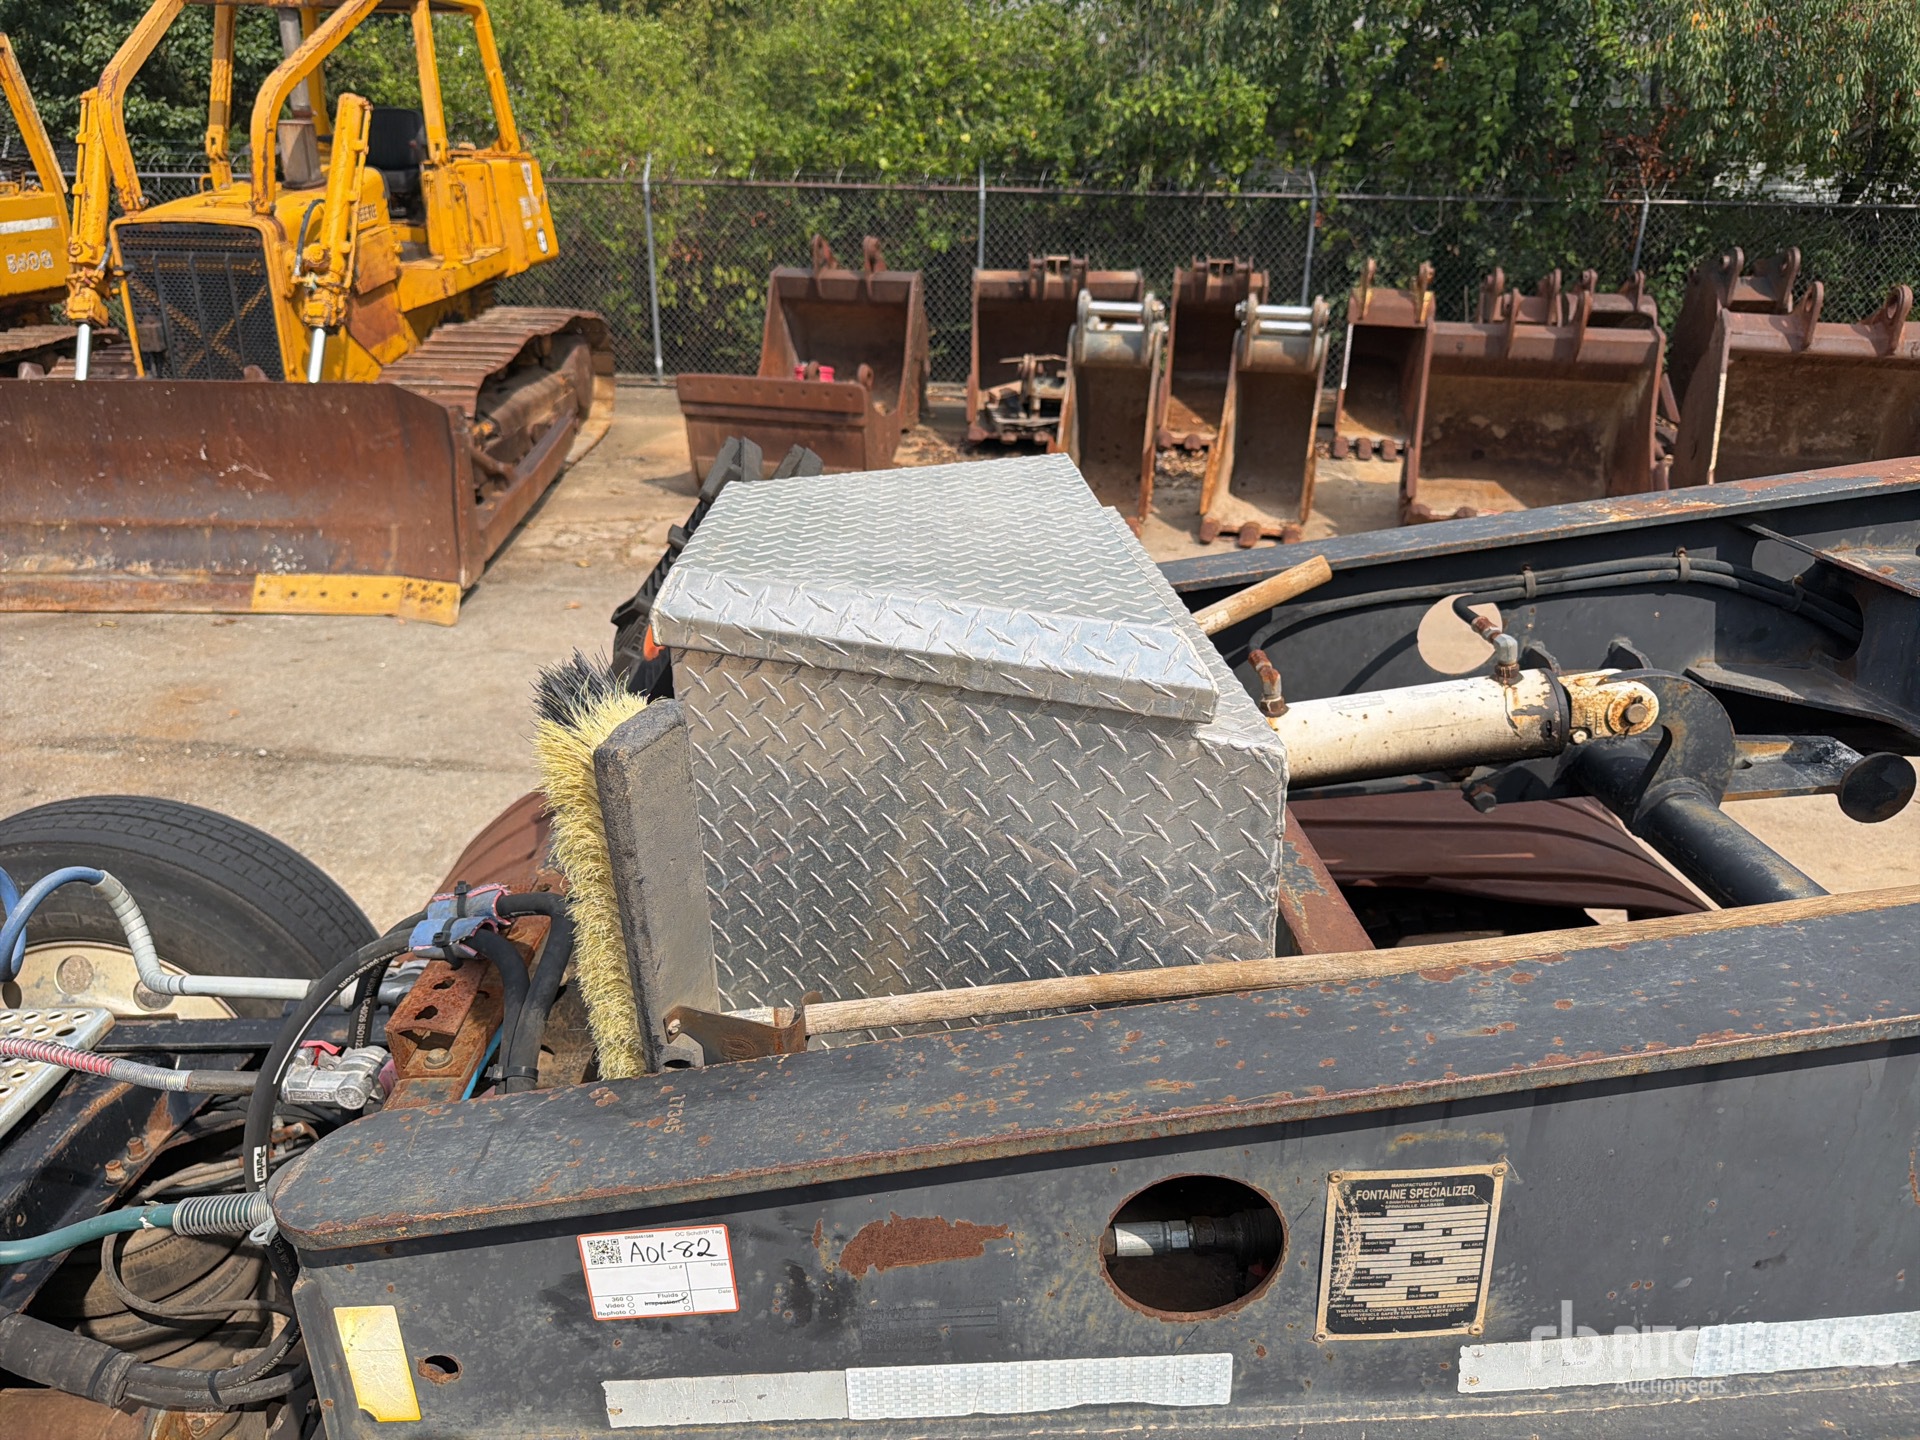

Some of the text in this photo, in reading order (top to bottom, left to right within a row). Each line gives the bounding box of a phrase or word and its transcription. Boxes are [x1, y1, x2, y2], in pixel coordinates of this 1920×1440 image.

[338, 950, 399, 989] www.parker.com
[256, 1151, 266, 1179] Parker
[1355, 1184, 1476, 1202] FONTAINE SPECIALIZED
[630, 1237, 718, 1264] A01-82
[597, 1309, 627, 1317] Rephoto
